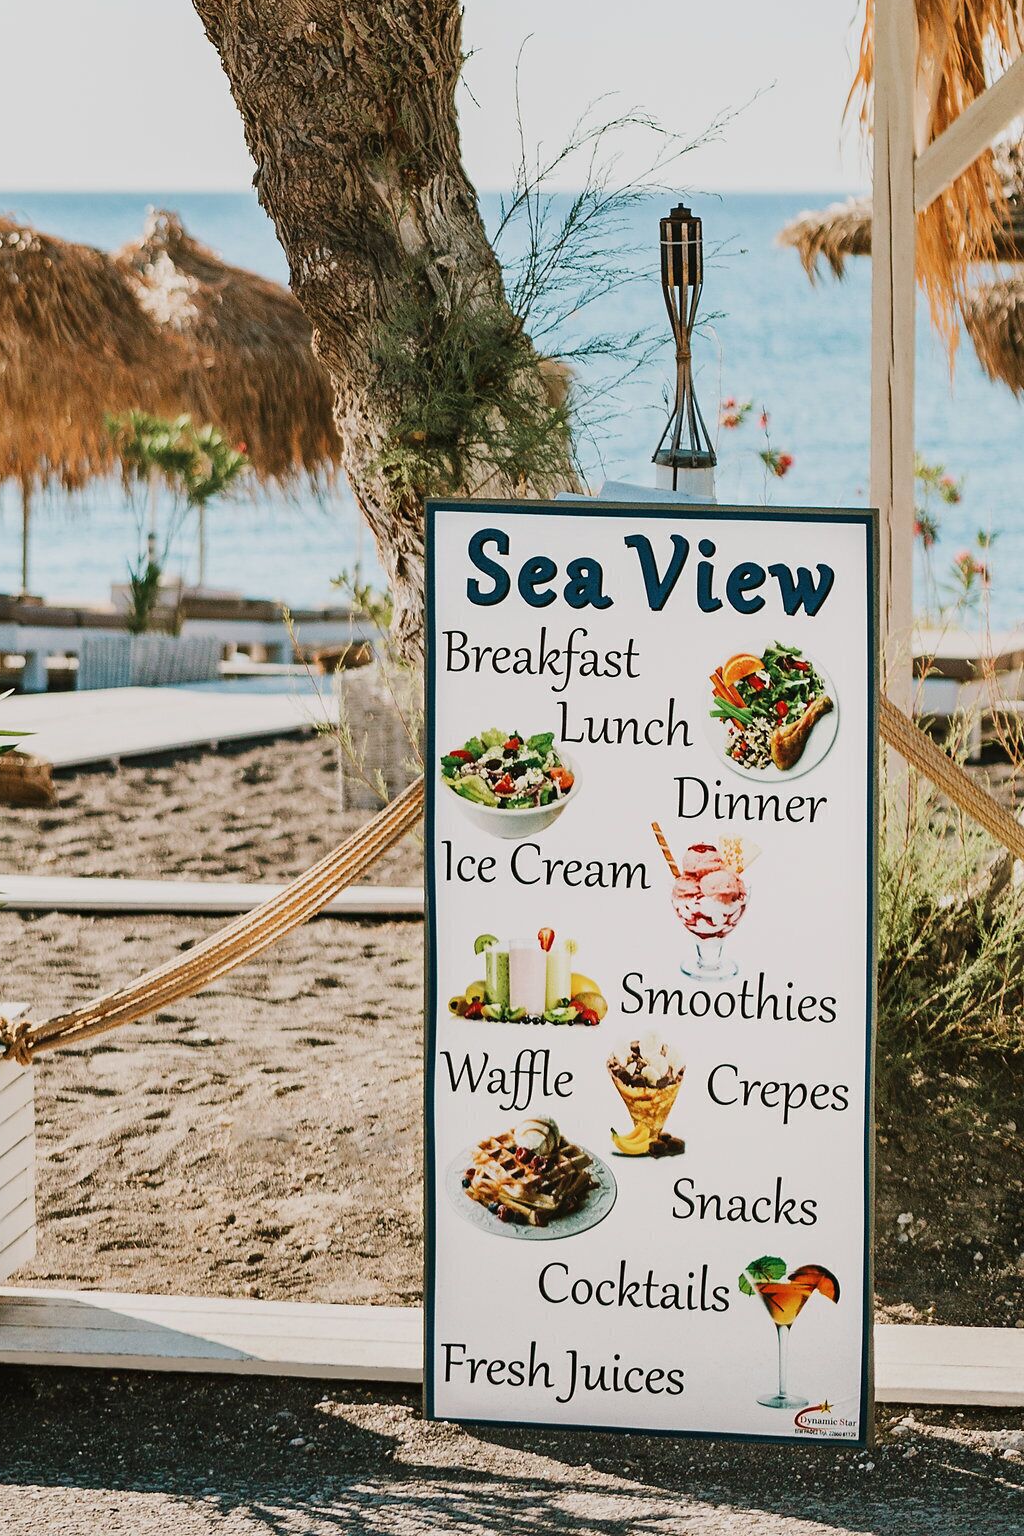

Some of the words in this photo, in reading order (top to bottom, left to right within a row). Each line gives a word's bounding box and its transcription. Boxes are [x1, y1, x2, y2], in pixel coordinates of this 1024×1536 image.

[467, 528, 614, 609] Sea
[624, 535, 834, 617] View
[442, 627, 640, 692] Breakfast
[558, 698, 693, 746] Lunch
[674, 774, 827, 822] Dinner
[442, 841, 496, 882] Ice
[511, 843, 650, 889] Cream
[622, 970, 836, 1023] Smoothies
[440, 1049, 573, 1111] Waffle
[708, 1064, 848, 1124] Crepes
[673, 1177, 817, 1225] Snacks
[539, 1260, 729, 1312] Cocktails
[441, 1341, 553, 1388] Fresh
[556, 1350, 684, 1403] Juices
[800, 1416, 838, 1425] Dynamic
[839, 1418, 857, 1426] Star
